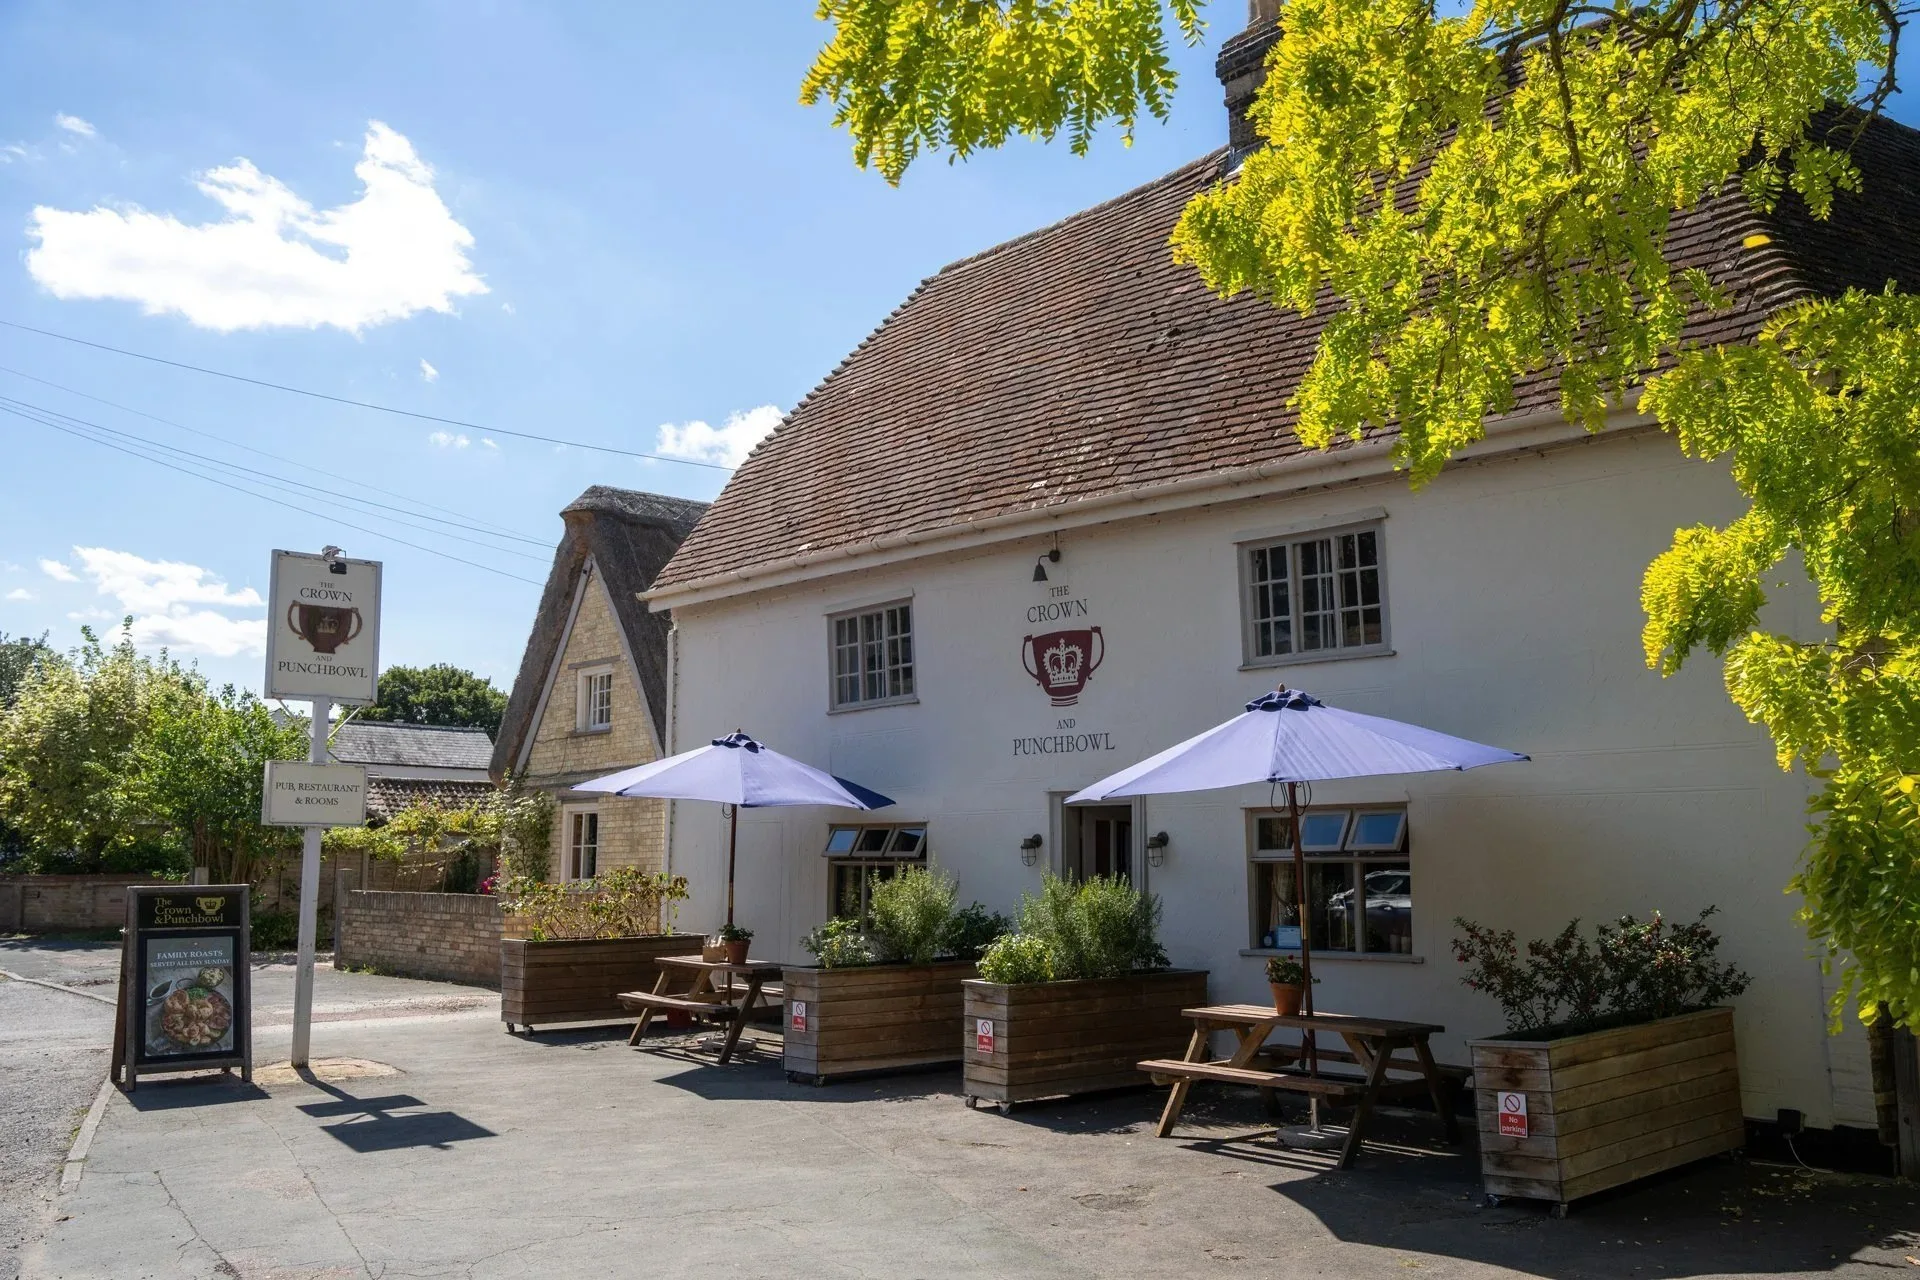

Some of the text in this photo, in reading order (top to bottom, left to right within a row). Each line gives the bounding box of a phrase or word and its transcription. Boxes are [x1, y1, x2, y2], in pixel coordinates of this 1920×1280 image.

[320, 581, 335, 589] THE
[300, 587, 353, 602] CROWN
[1049, 585, 1070, 598] THE
[1027, 599, 1088, 623] CROWN
[278, 661, 368, 678] PUNCHBOWL
[1056, 718, 1076, 730] AND
[1013, 732, 1116, 756] PUNCHBOWL
[275, 782, 360, 792] PUB, RESTAURANT
[295, 797, 339, 805] & ROOMS
[154, 897, 172, 906] The
[154, 905, 192, 915] Crown
[157, 950, 223, 960] FAMILY ROASTS
[1509, 1116, 1518, 1124] No
[1502, 1125, 1526, 1135] parking
